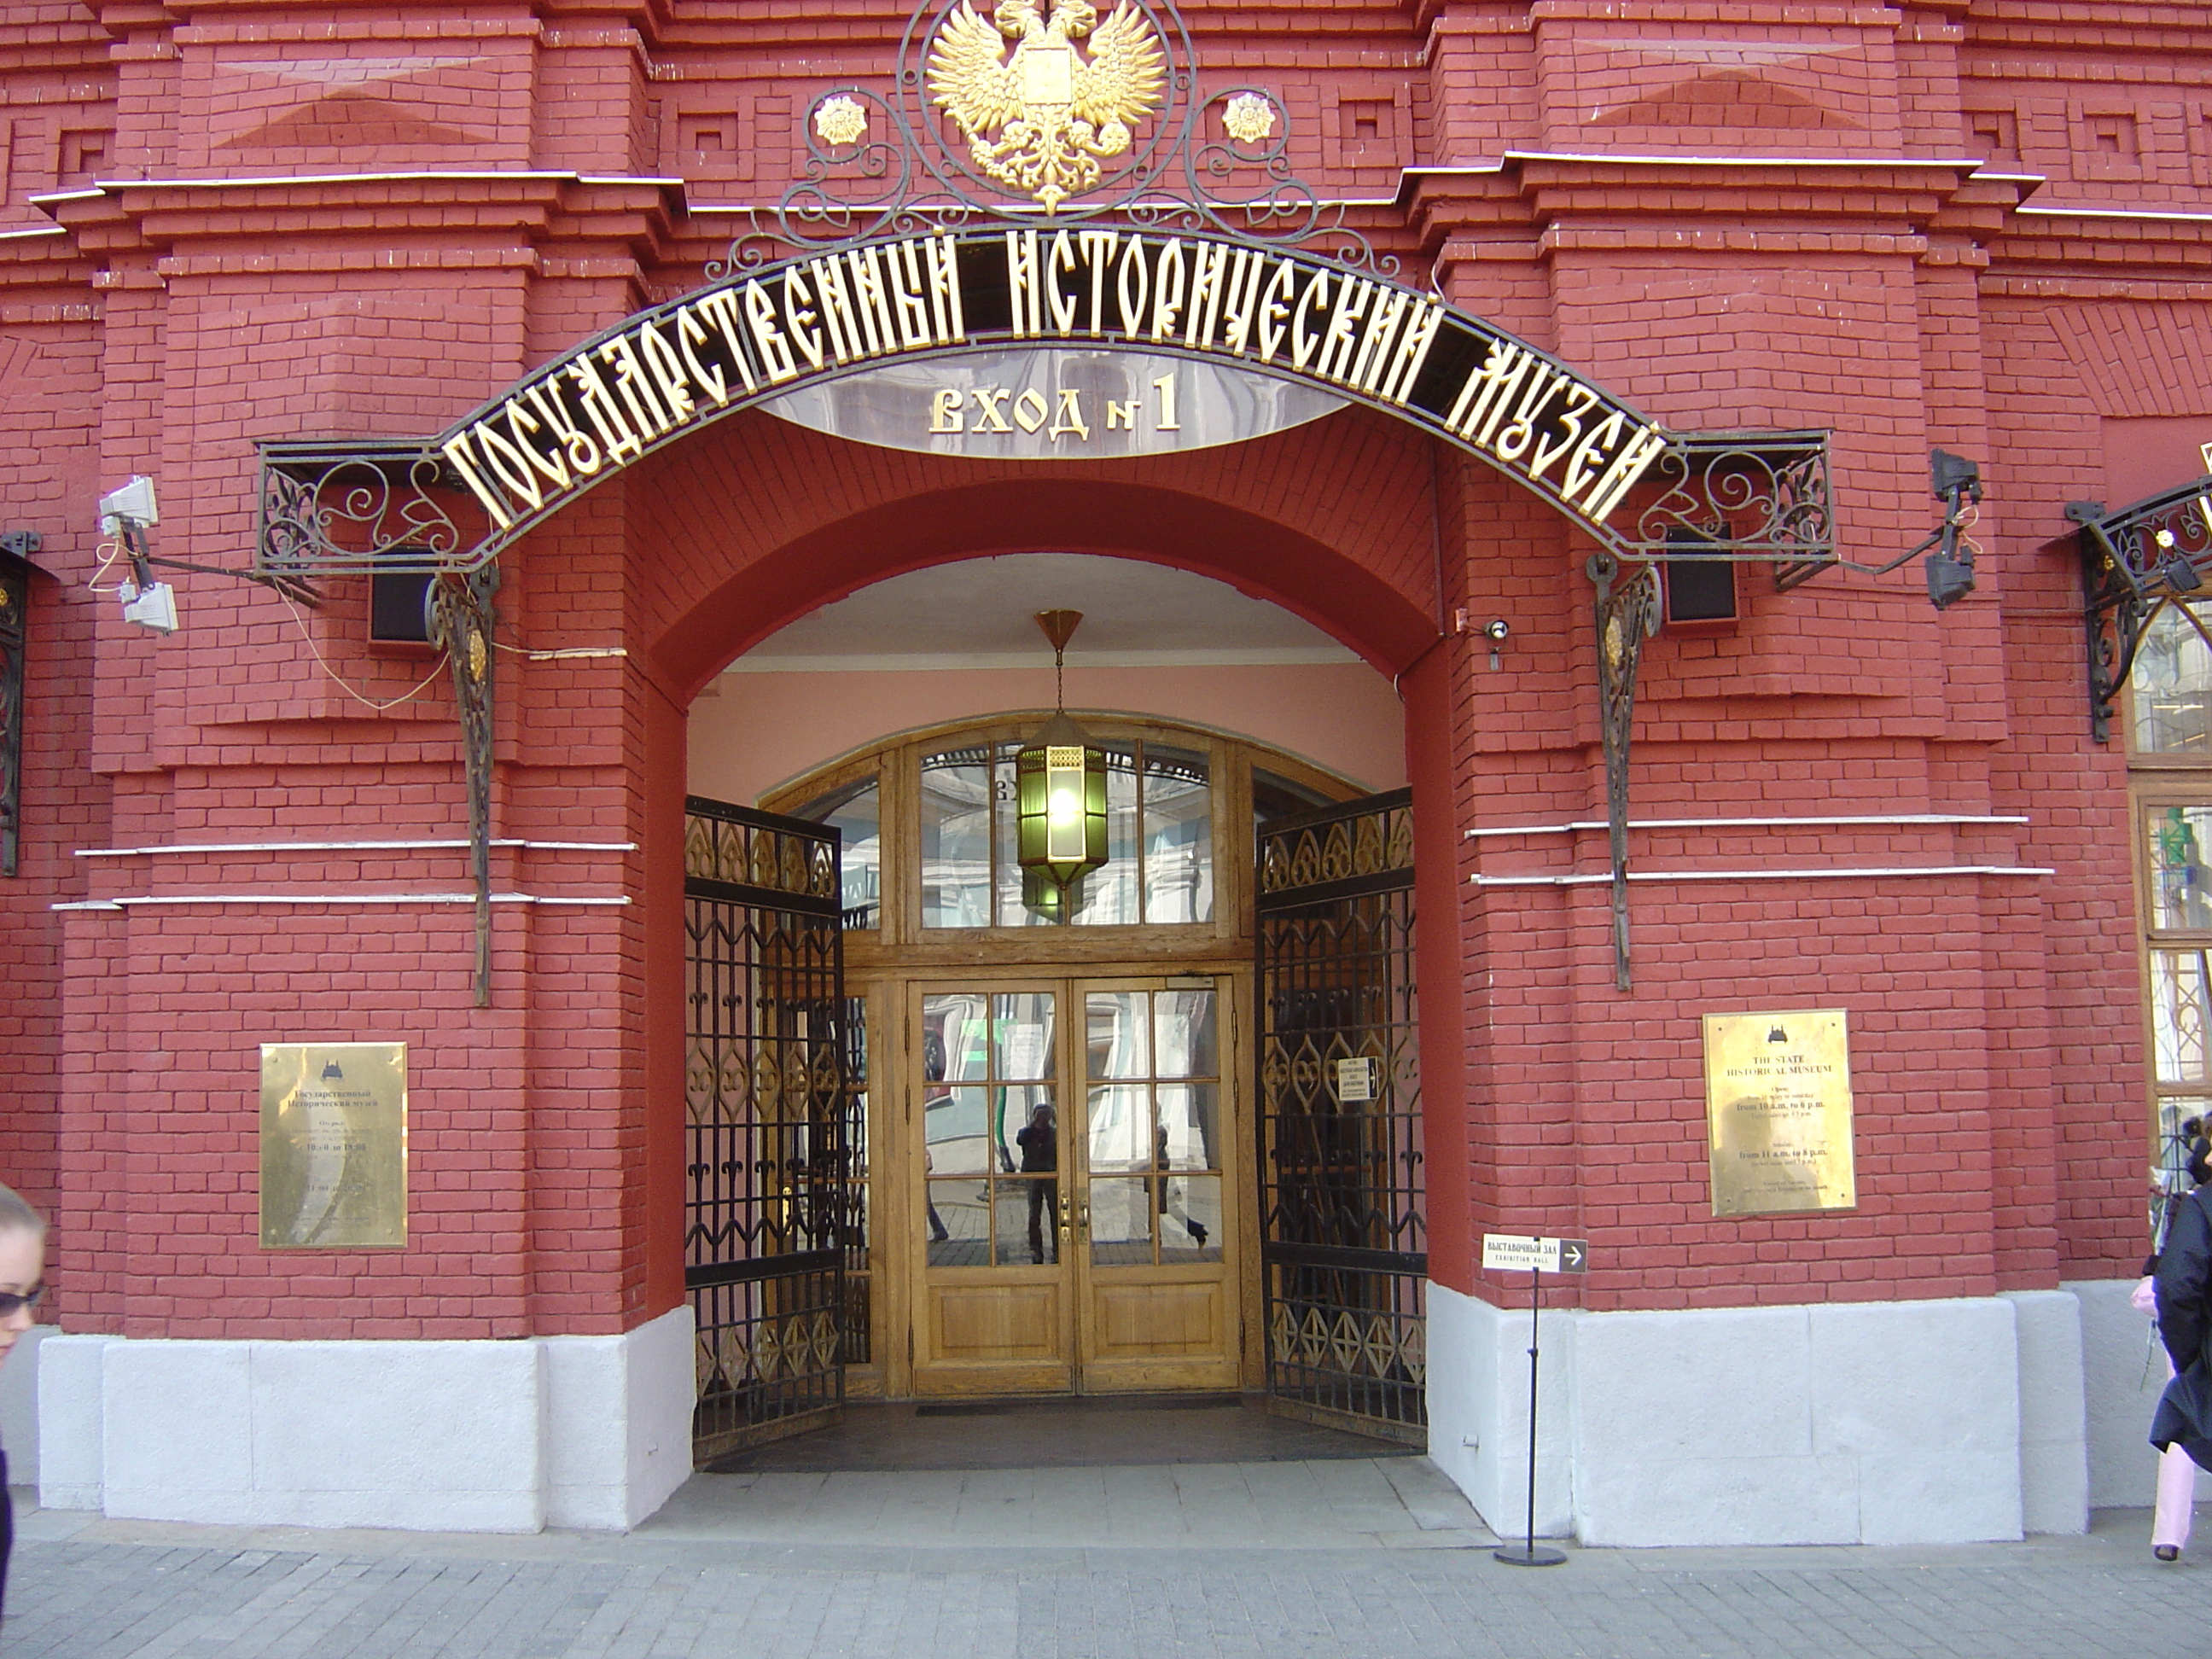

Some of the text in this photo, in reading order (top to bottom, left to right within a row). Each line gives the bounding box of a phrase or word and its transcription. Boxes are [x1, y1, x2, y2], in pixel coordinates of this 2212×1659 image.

[442, 225, 1666, 531] ГОСУДАРСТВЕННЫЙ ИСТОРИЧЕСКИЙ МУЗЕЙ
[928, 387, 1089, 441] ВХОД
[1153, 372, 1181, 430] 1
[1753, 1054, 1805, 1065] THE STATE
[1726, 1064, 1832, 1077] HISTORICAL MUSEUM
[294, 1088, 371, 1099] Государственный
[288, 1099, 378, 1109] Исторический музей
[1737, 1103, 1757, 1111] from
[1760, 1102, 1768, 1110] 10
[1807, 1101, 1826, 1110] p.m.
[1739, 1150, 1759, 1159] from
[1809, 1149, 1828, 1158] p.m.
[1487, 1241, 1557, 1255] ВЫСТАВОЧНЫЙ ЗАЛ
[1495, 1254, 1530, 1263] EXHIBITION
